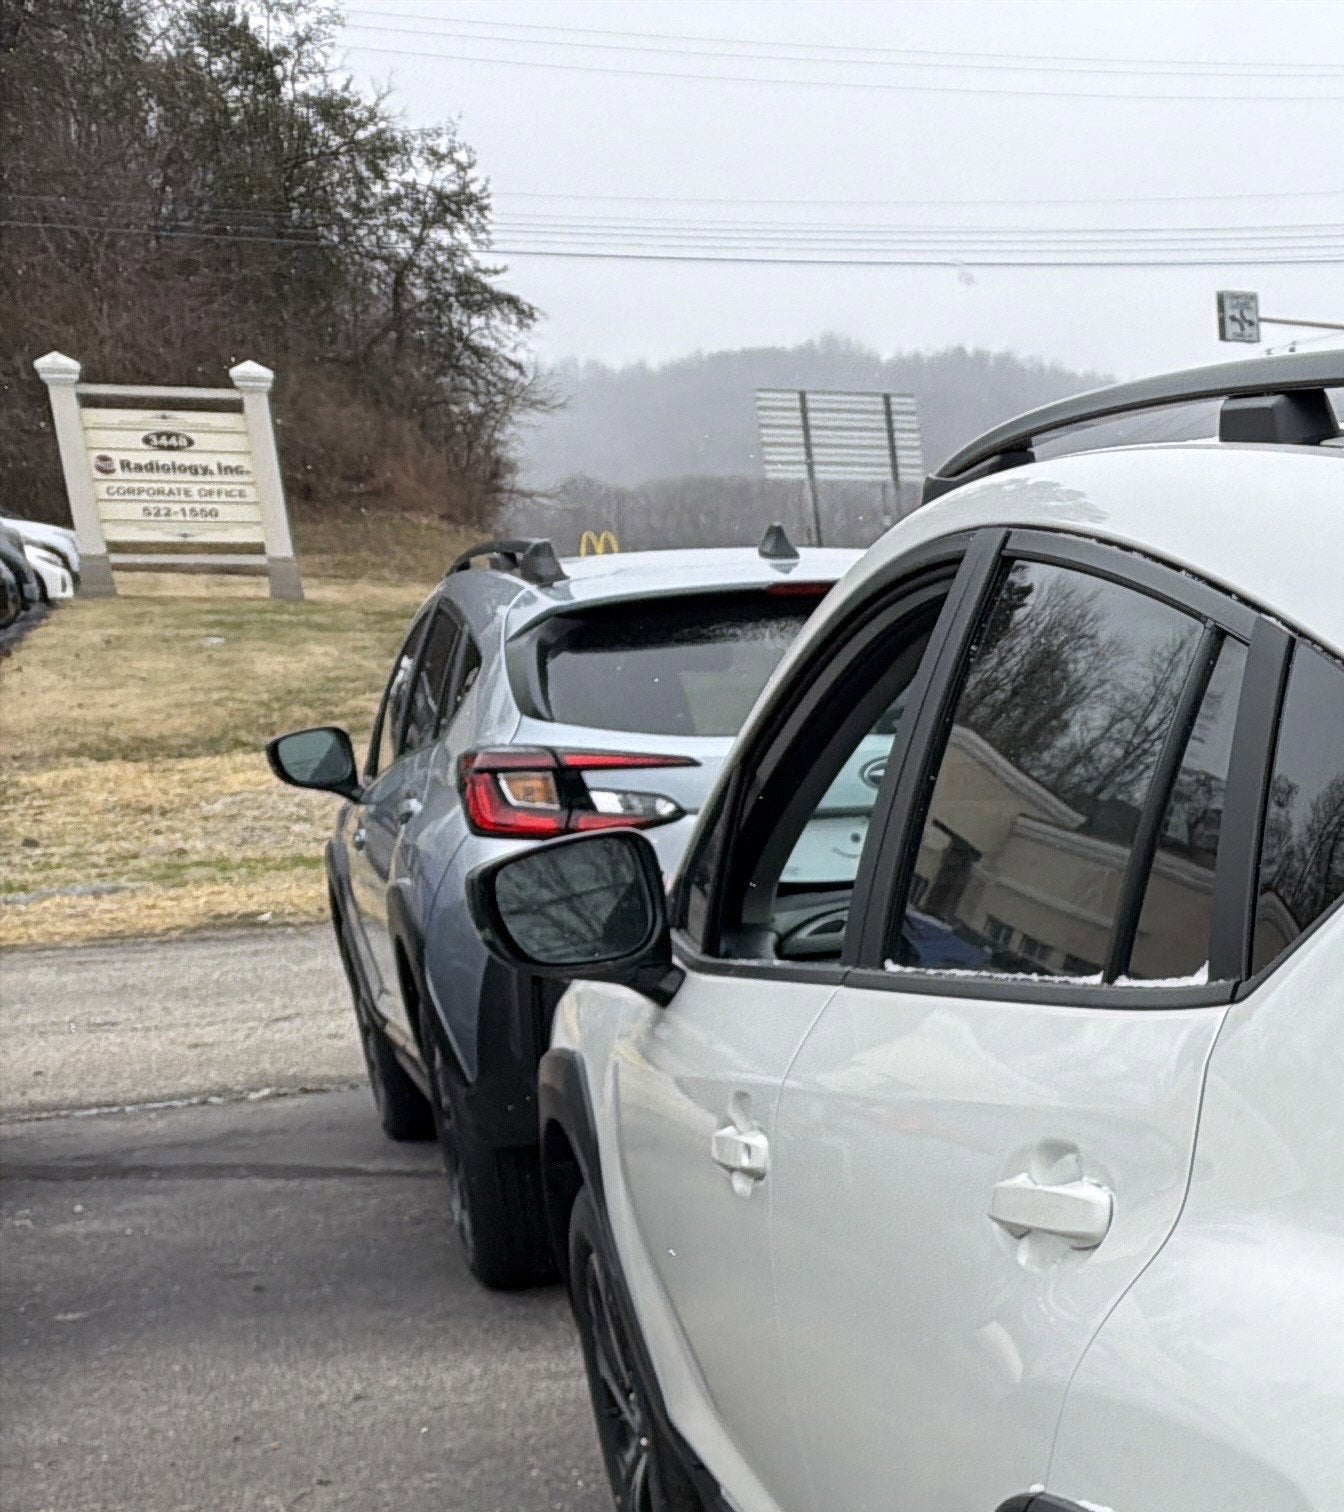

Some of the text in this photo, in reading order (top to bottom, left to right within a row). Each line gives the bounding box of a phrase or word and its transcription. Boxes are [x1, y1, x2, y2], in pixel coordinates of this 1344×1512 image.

[118, 458, 251, 476] Radiology, Inc.
[105, 485, 248, 499] CORPORATE OFFICE
